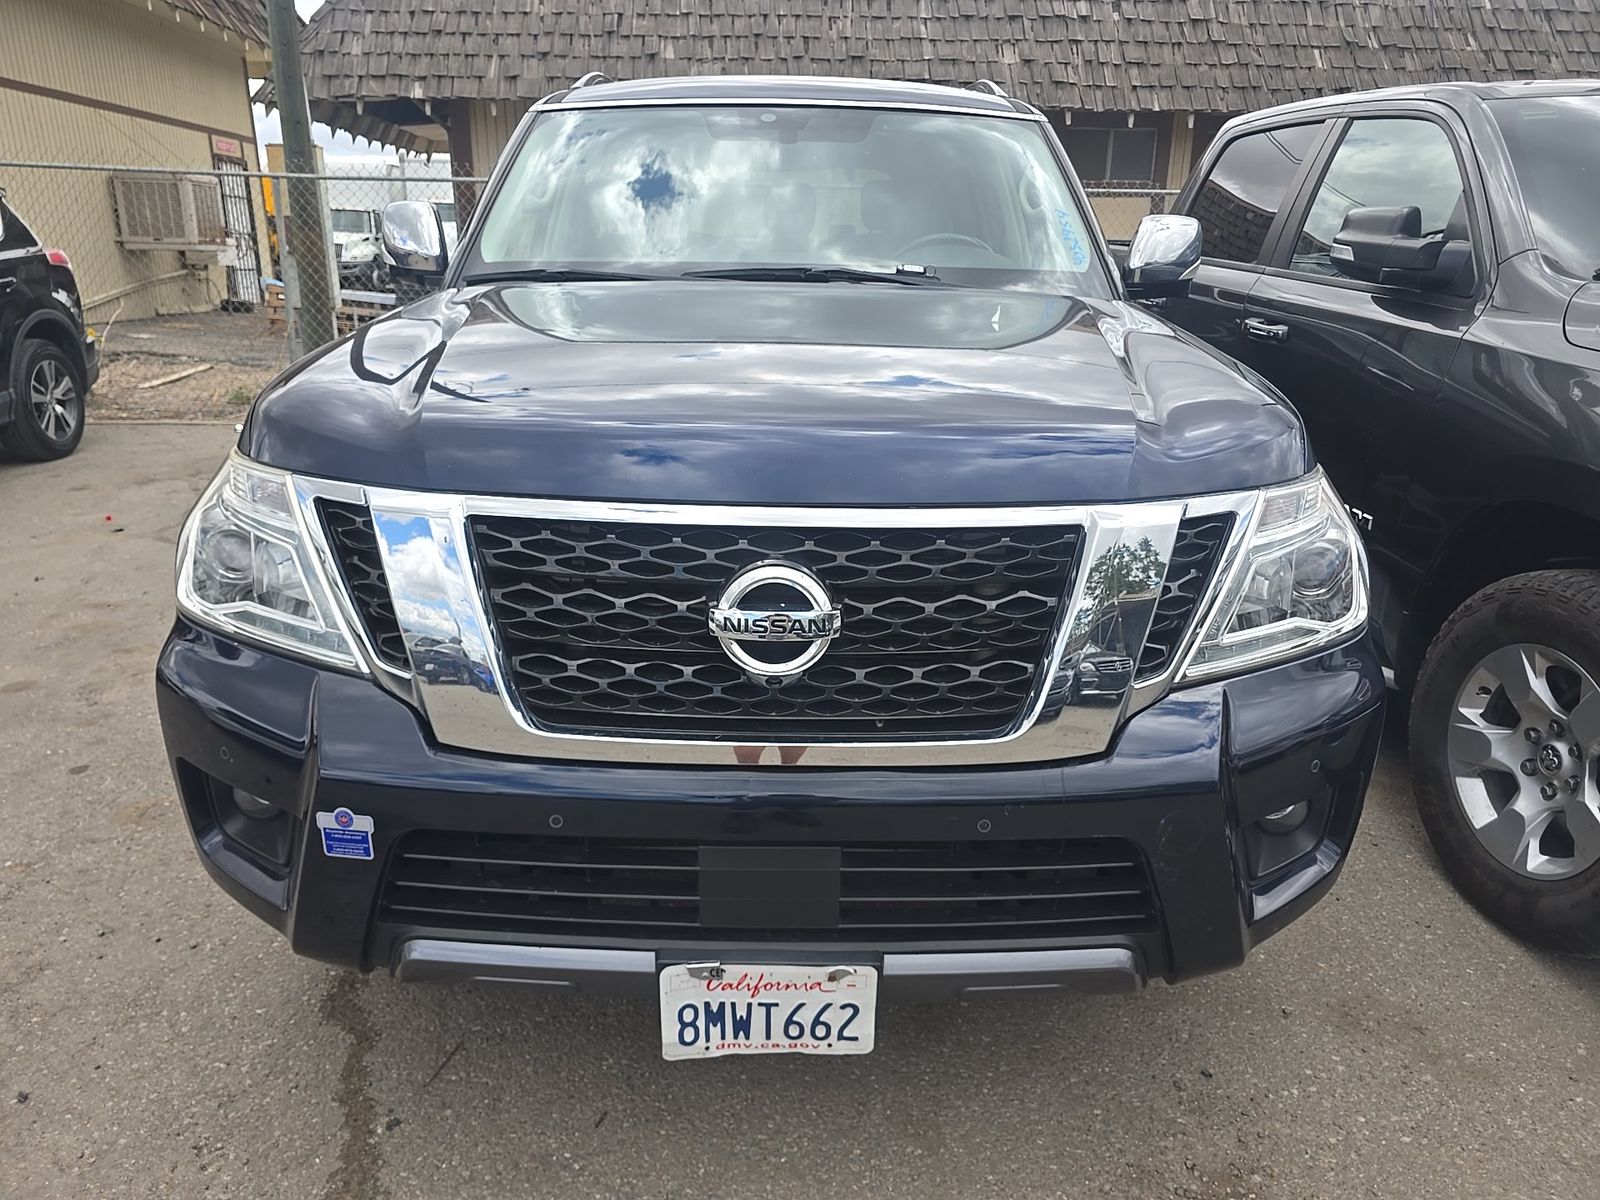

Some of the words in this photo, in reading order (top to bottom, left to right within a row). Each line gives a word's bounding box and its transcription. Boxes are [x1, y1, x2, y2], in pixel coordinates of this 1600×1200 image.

[723, 616, 827, 635] NISSAN
[706, 972, 837, 999] California
[677, 1000, 860, 1047] 8MWT662
[715, 1042, 821, 1051] dmv.ca.gov
